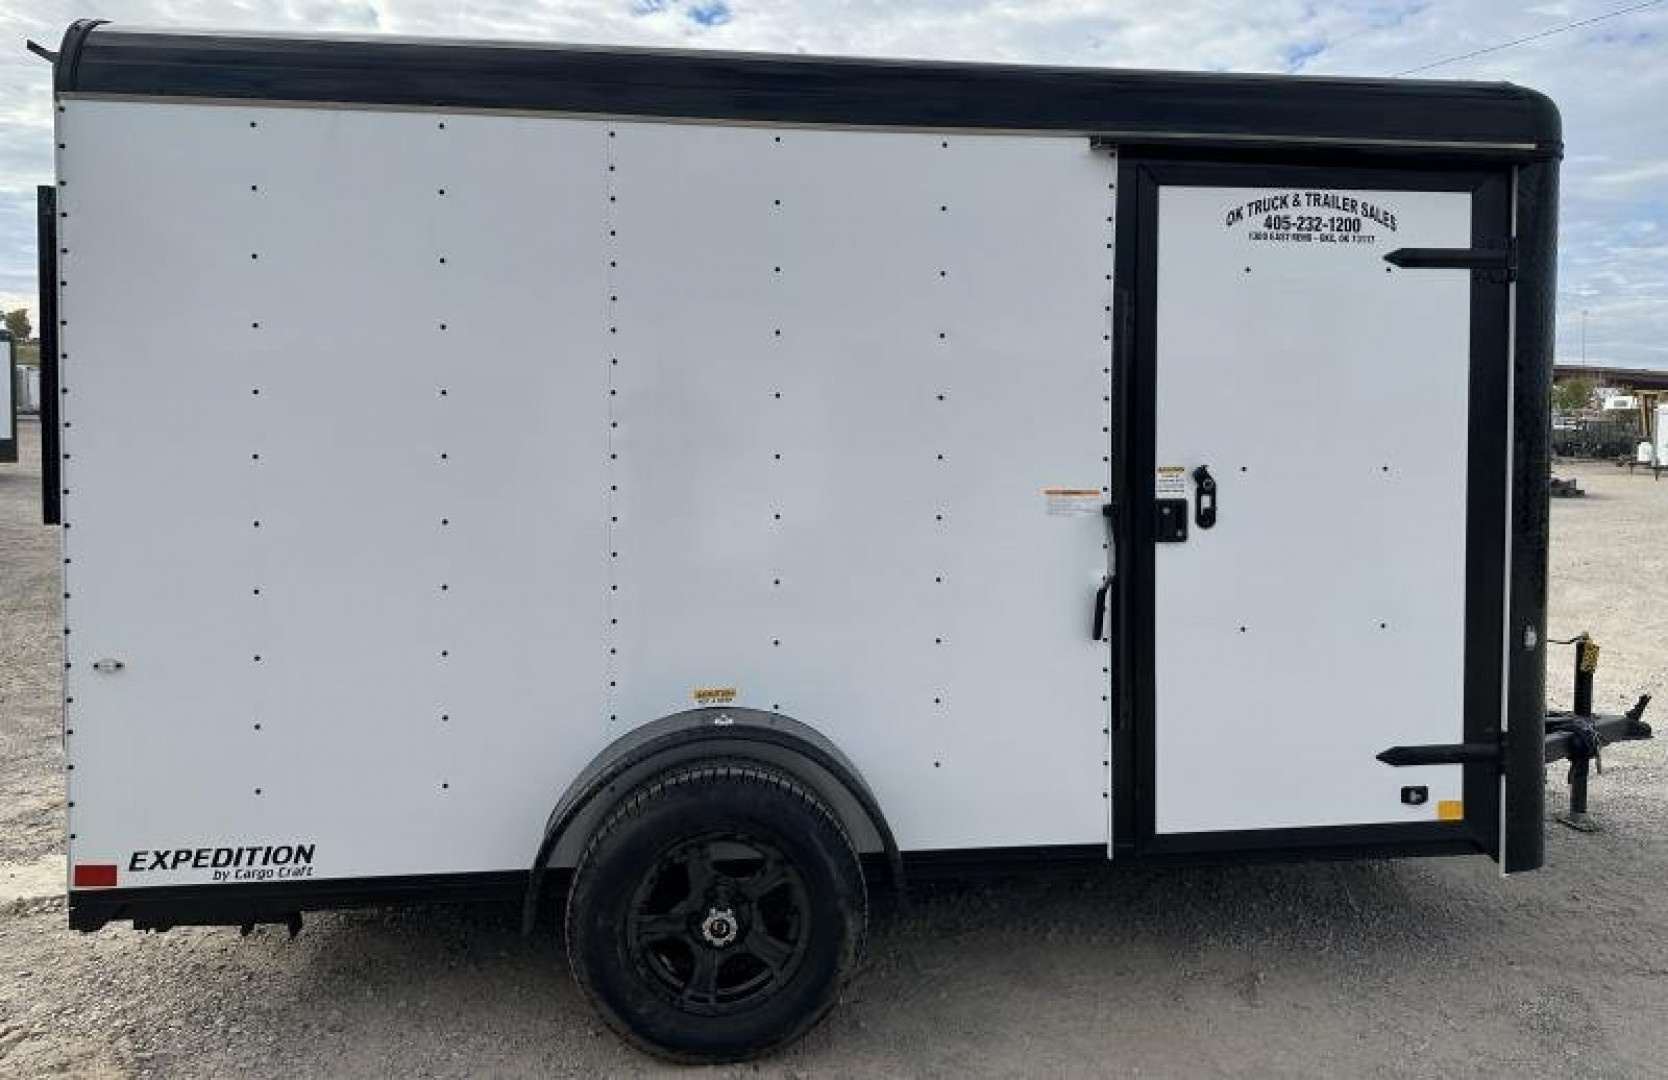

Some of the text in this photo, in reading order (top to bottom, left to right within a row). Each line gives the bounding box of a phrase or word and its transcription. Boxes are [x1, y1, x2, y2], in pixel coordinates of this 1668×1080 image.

[1226, 192, 1397, 232] OK TRUCK & TRAILER SALES
[1263, 214, 1362, 232] 405-232-1200
[129, 843, 316, 872] EXPEDITION
[212, 865, 314, 882] by Cargo Craft
